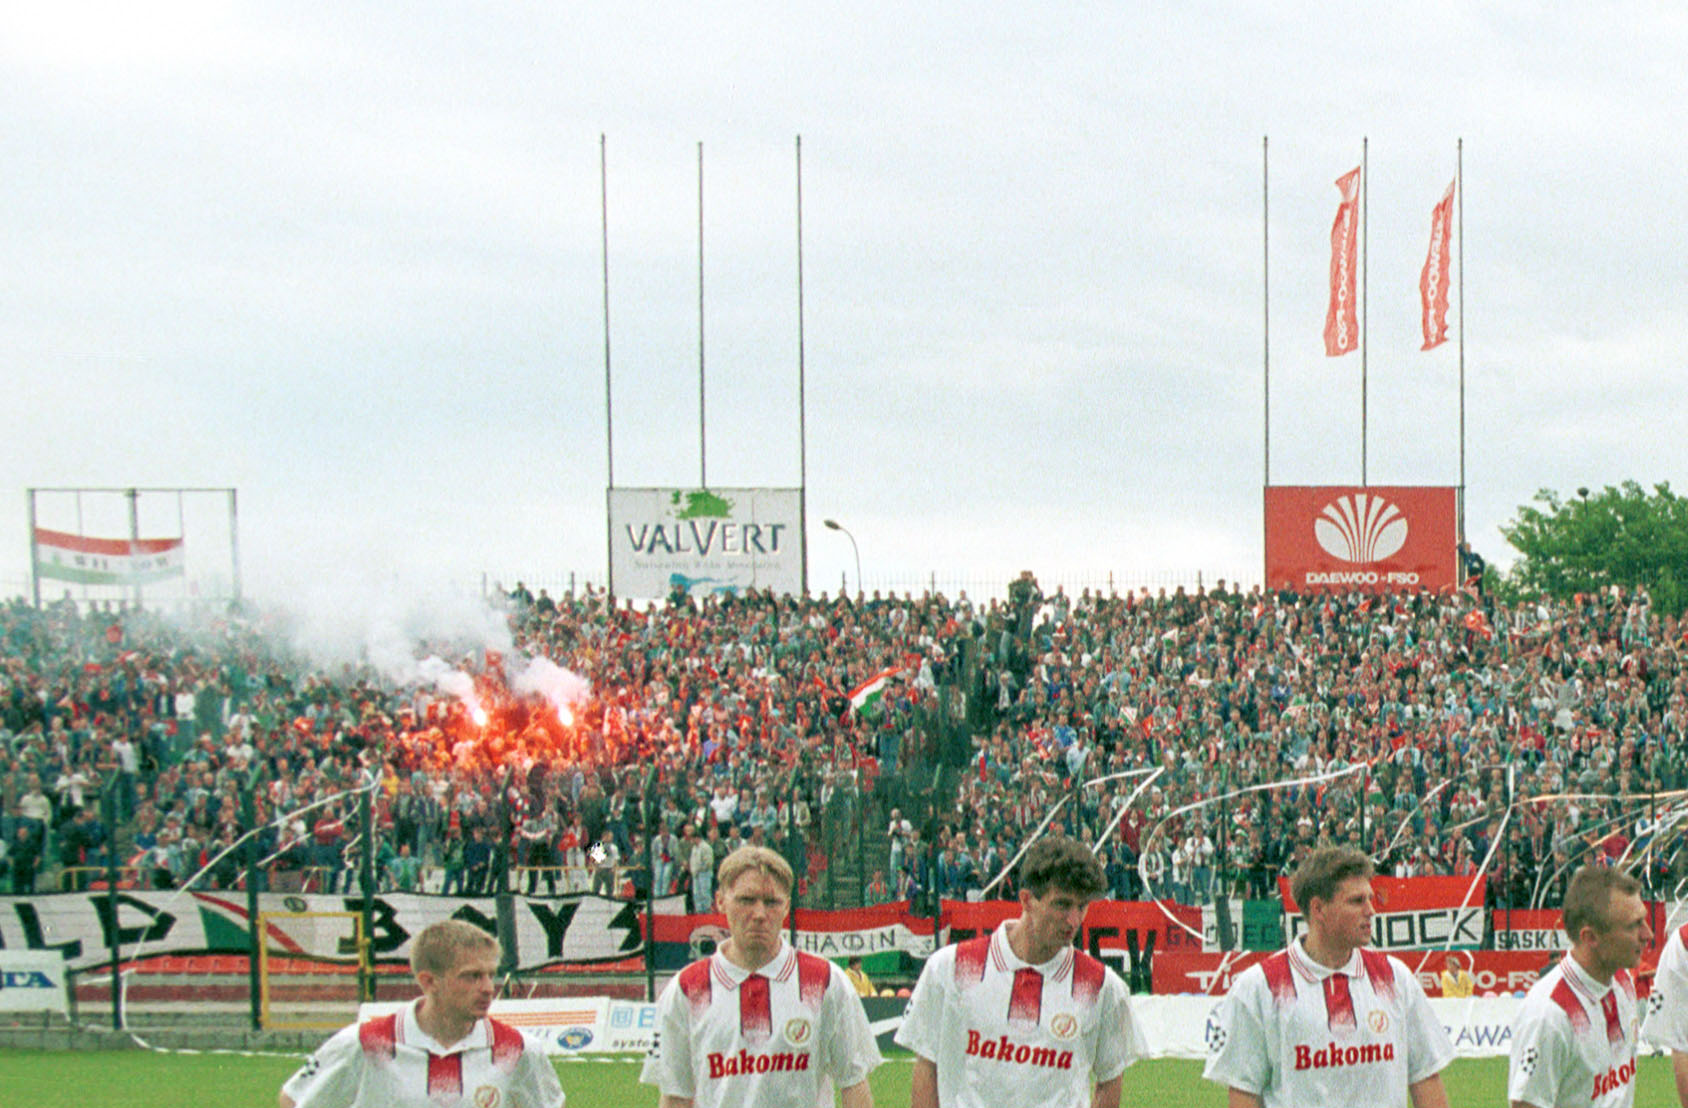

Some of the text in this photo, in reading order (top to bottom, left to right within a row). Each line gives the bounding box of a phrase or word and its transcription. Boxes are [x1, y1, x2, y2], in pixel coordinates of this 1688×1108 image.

[626, 520, 786, 556] VALVERT
[707, 1048, 809, 1079] Bakoma
[965, 1029, 1073, 1070] Bakoma
[1295, 1042, 1395, 1070] Bakoma
